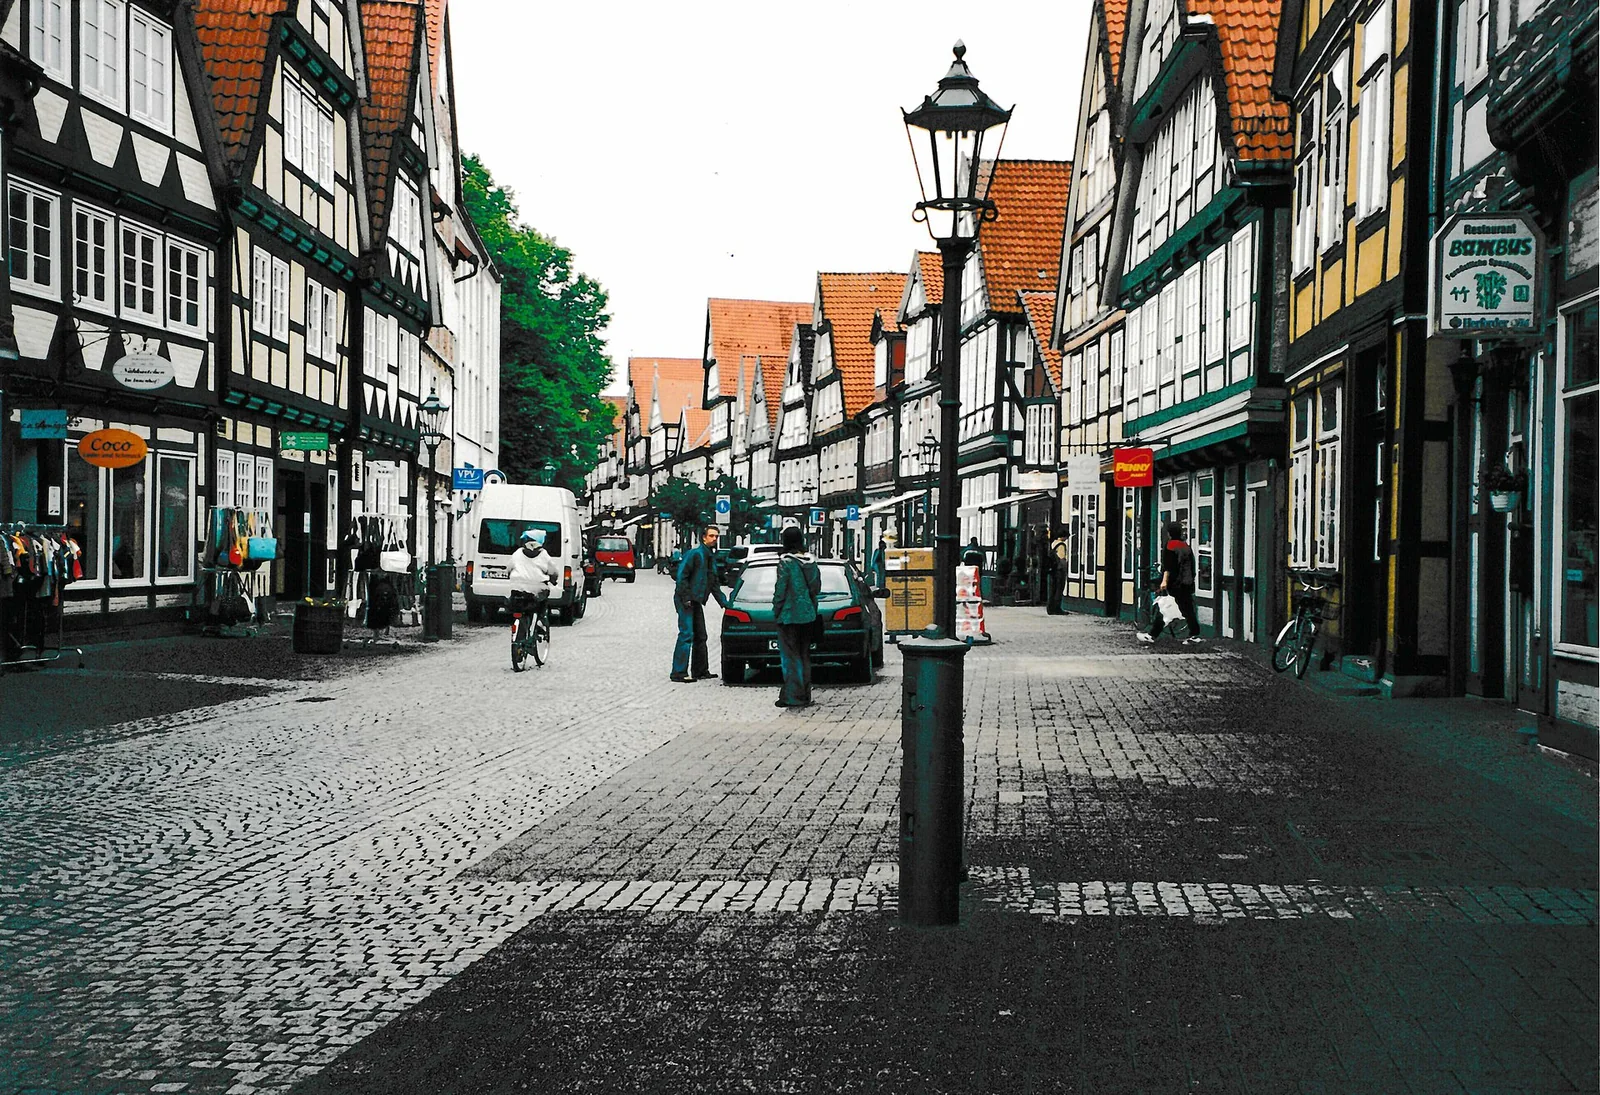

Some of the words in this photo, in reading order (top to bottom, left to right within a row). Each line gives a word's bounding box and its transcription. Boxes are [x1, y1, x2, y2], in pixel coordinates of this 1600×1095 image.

[1464, 224, 1517, 235] Restaurant
[91, 438, 134, 451] Coco
[1116, 462, 1151, 472] PENNY
[458, 470, 475, 478] VPV
[850, 507, 856, 519] P
